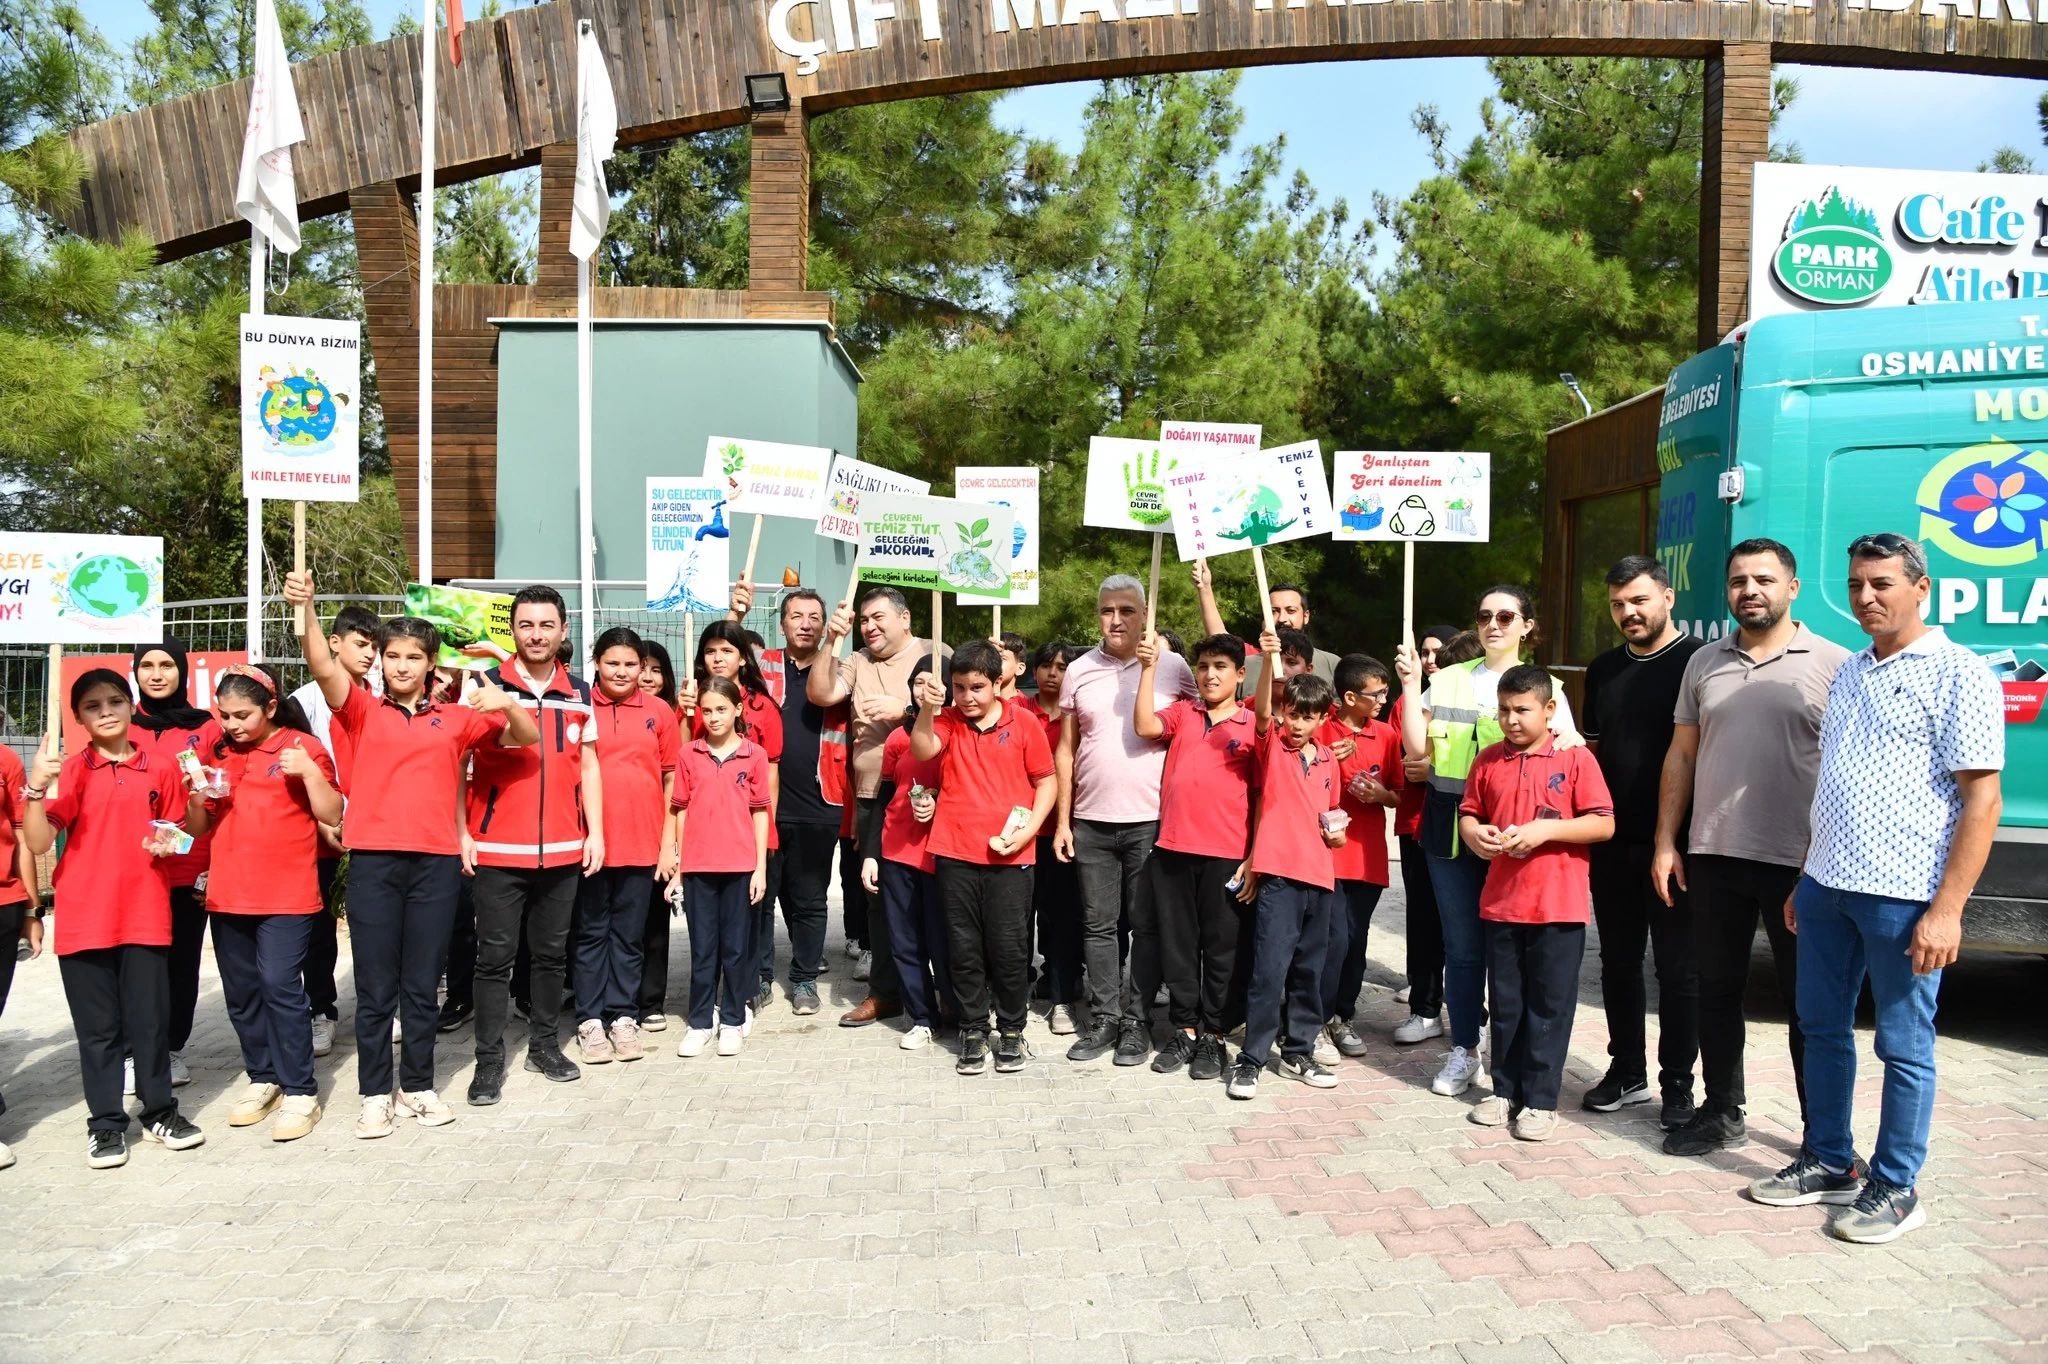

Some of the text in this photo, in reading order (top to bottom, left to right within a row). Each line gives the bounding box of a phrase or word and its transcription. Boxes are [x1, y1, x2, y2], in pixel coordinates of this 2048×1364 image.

[1903, 193, 2025, 241] Cafe
[1791, 243, 1879, 268] PARK
[1795, 270, 1874, 290] ORMAN
[245, 332, 357, 350] BU DÜNYA BİZİM
[1861, 341, 2045, 376] OSMANİYE
[1665, 374, 1721, 425] BELEDİYESİ
[1166, 428, 1256, 446] DOĞAYI YAŞATMAK
[1278, 450, 1314, 464] TEMİZ
[1362, 454, 1430, 470] Yanlıştan
[251, 468, 351, 484] KİRLETMEYELİM
[1170, 472, 1206, 486] TEMİZ
[1350, 473, 1442, 490] Geri dönelim
[750, 482, 781, 495] TEMİZ
[784, 487, 805, 499] BUL
[960, 478, 985, 490] ÇEVRE
[652, 489, 664, 500] SU
[652, 501, 691, 511] AKIP GİDEN
[1130, 501, 1148, 509] DUR
[652, 512, 703, 522] GELECEĞİMİZİN
[652, 524, 692, 538] ELİNDEN
[652, 539, 684, 551] TUTUN
[883, 544, 921, 556] KORU
[492, 603, 512, 612] TEMİ
[490, 615, 511, 624] TEMİ
